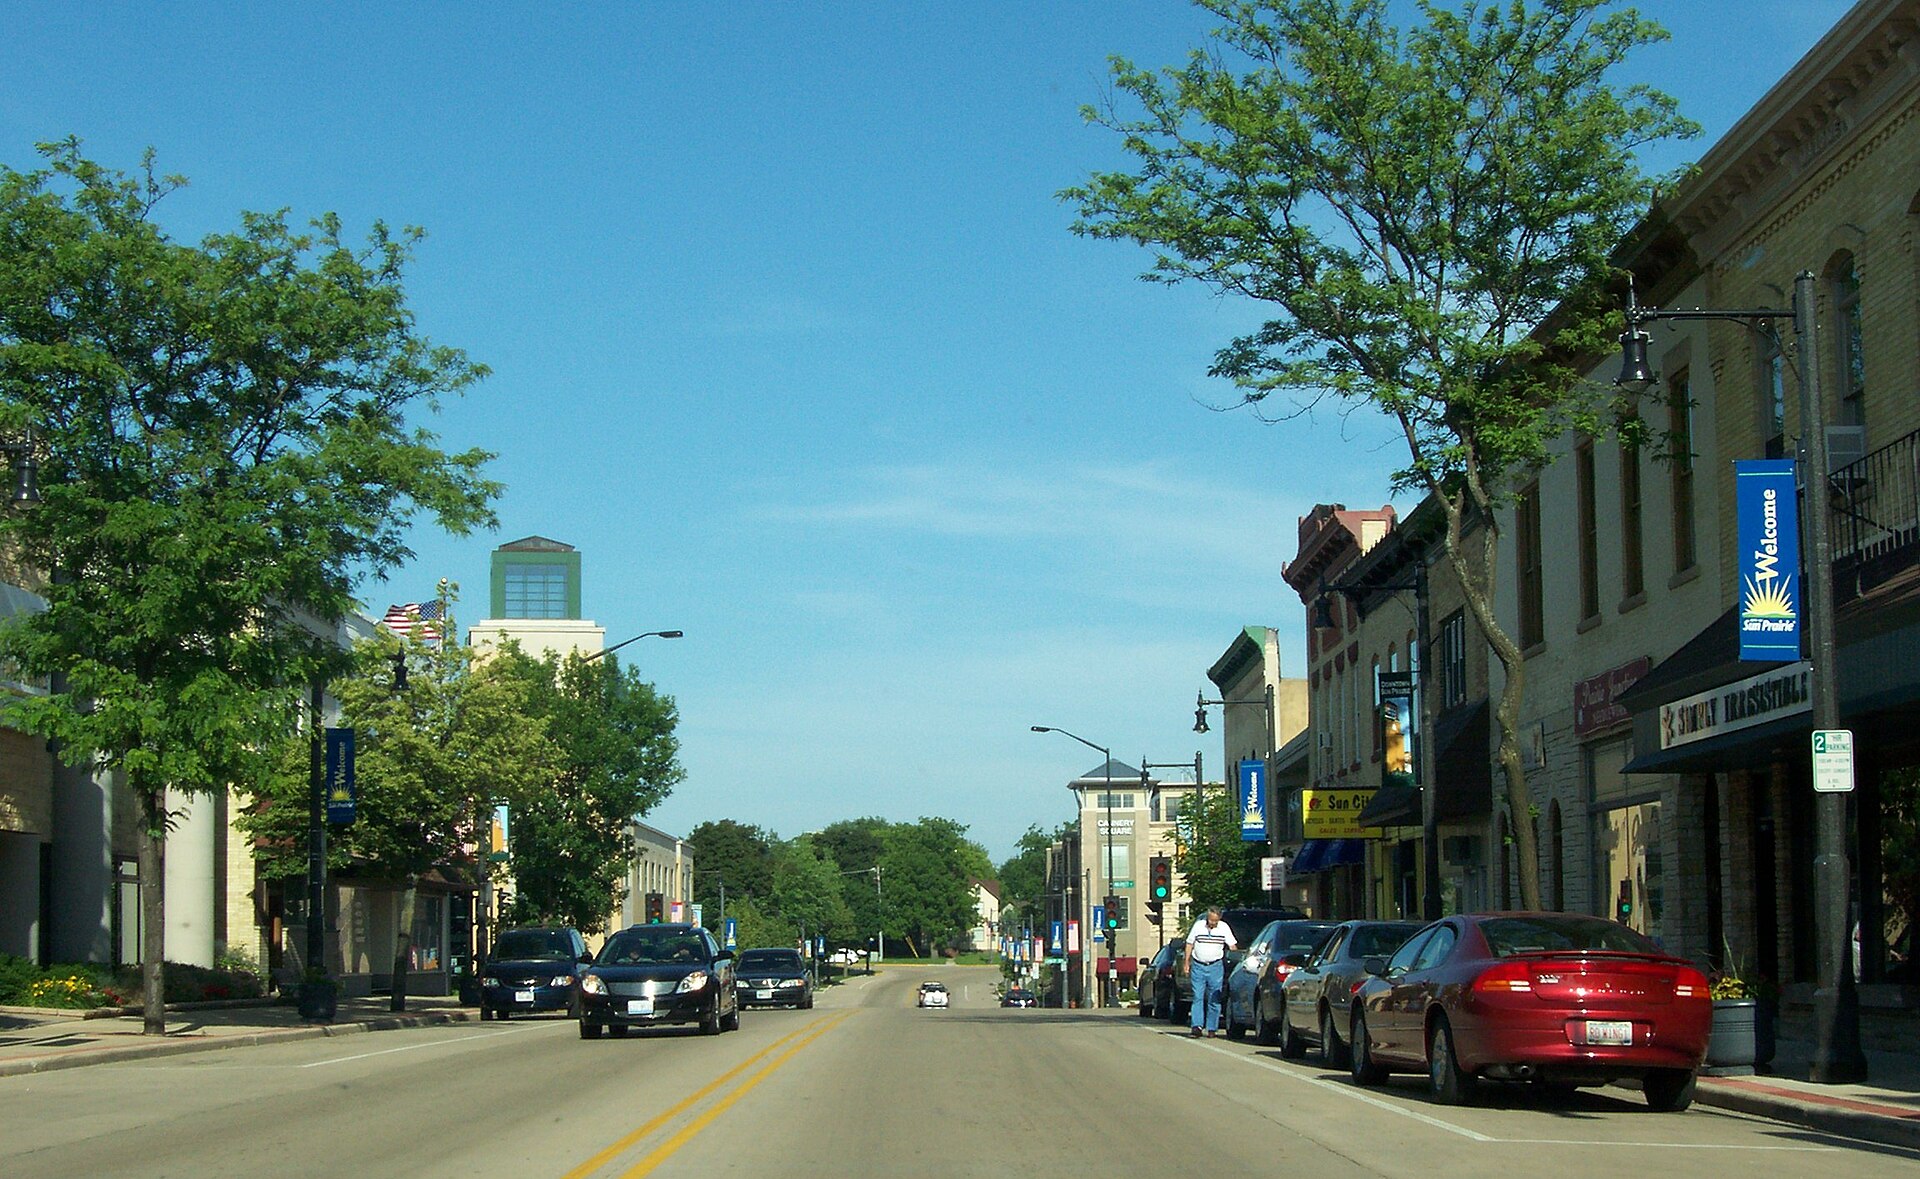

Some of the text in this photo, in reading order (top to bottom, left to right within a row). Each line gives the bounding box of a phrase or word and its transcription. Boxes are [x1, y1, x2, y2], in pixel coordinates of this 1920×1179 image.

[1755, 488, 1779, 582] Welcome
[1742, 619, 1795, 632] Sun Prairie
[1678, 697, 1717, 737] SIMPLY
[1724, 672, 1808, 723] IRRESISTIBLE
[1814, 735, 1825, 751] 2
[1826, 743, 1849, 751] PARKING
[334, 742, 346, 785] Welcome
[1247, 771, 1258, 810] Welcome
[1328, 794, 1369, 810] Sun Cit
